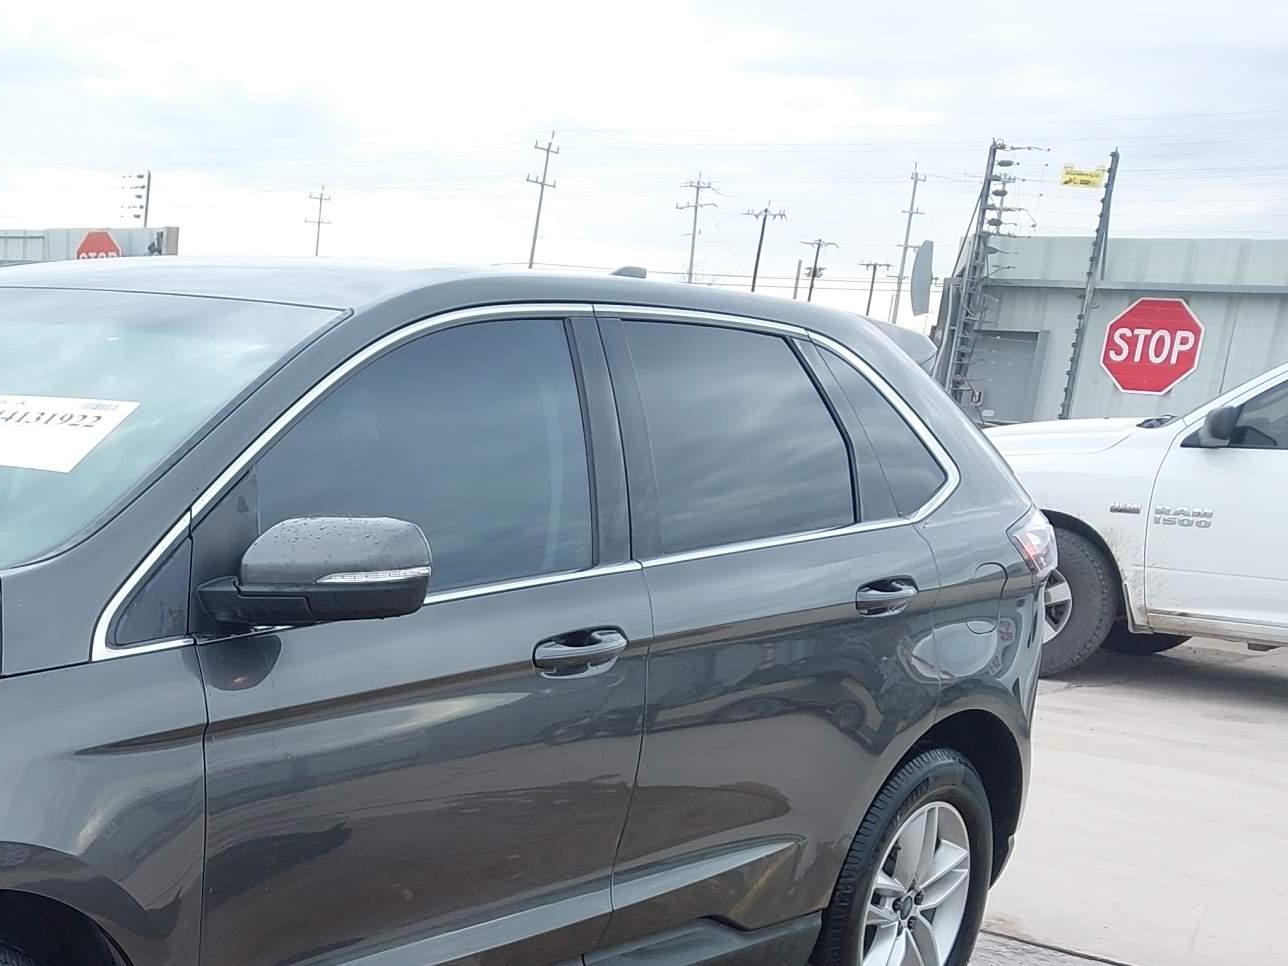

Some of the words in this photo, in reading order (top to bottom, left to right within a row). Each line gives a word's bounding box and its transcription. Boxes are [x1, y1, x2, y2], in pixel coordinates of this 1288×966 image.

[1109, 327, 1195, 364] STOP
[1154, 505, 1213, 518] RAM
[1153, 516, 1211, 528] 1500
